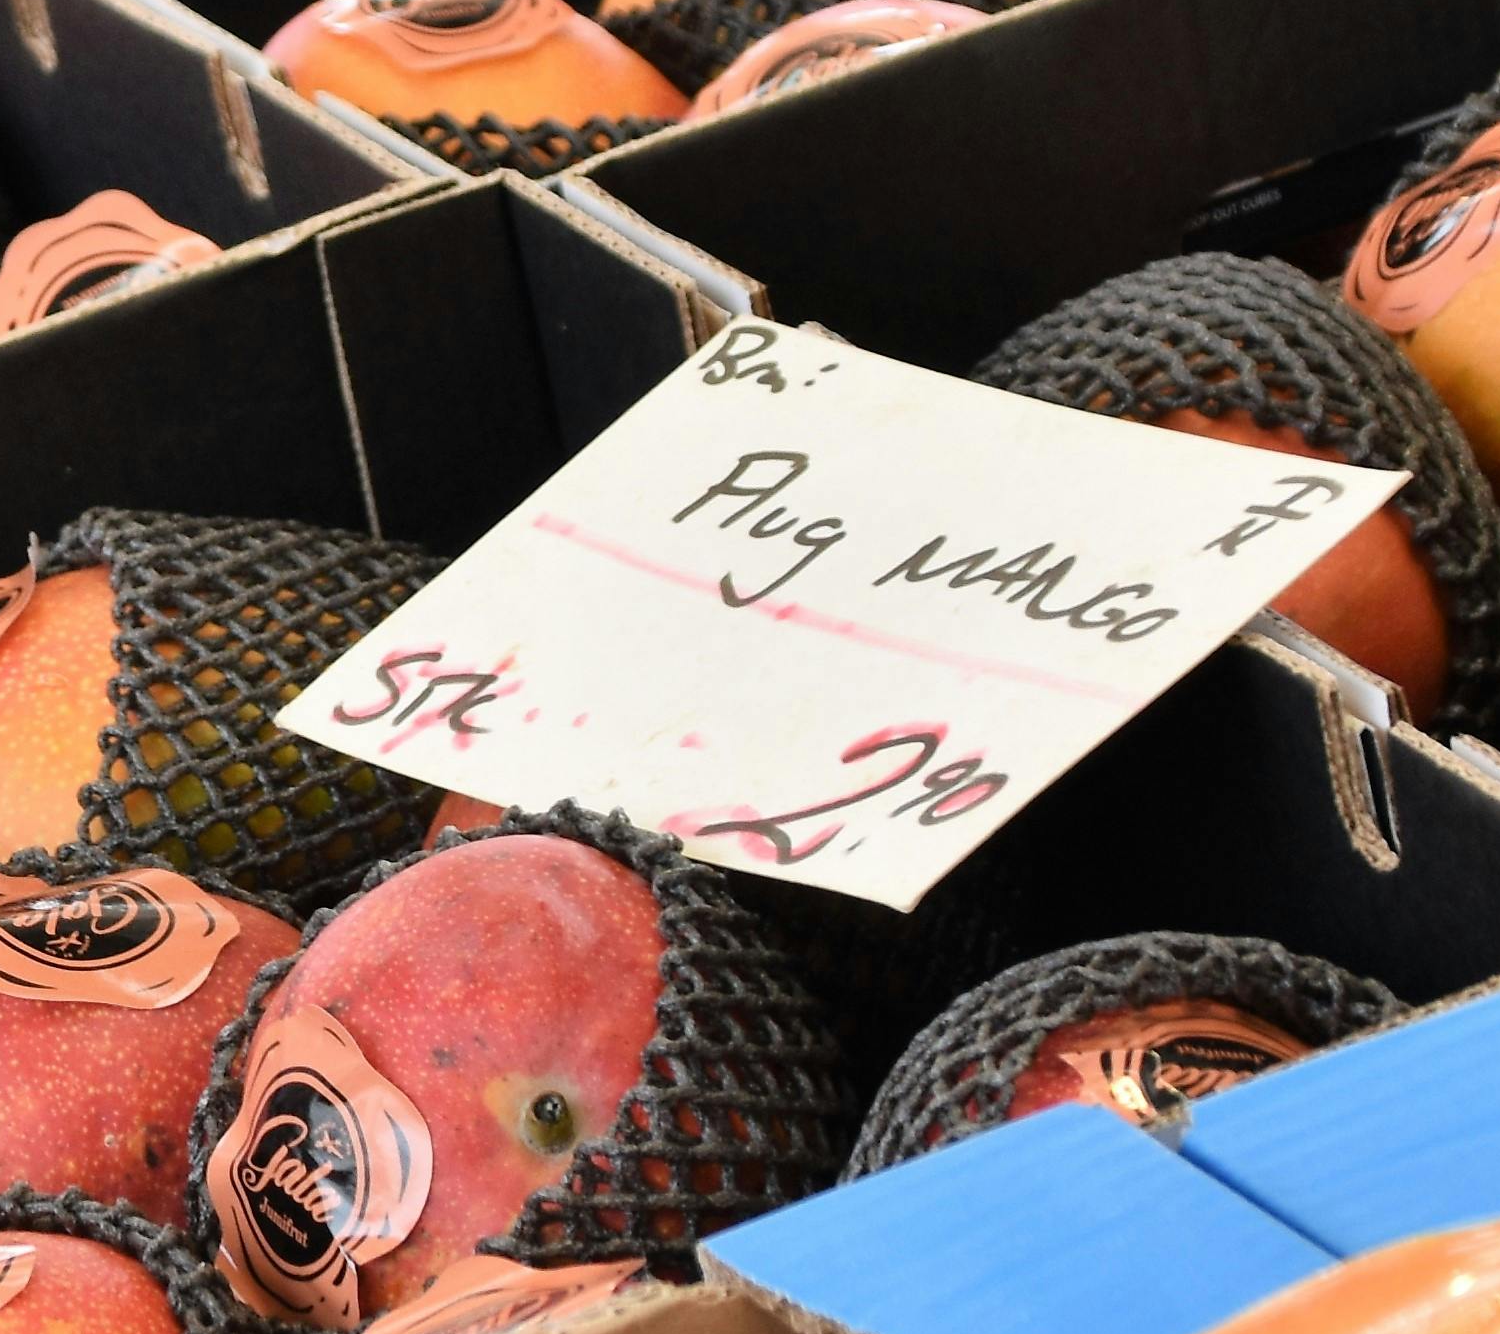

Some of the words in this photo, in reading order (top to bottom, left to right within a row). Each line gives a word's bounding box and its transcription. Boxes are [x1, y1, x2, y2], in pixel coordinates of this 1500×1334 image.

[672, 450, 847, 607] Flug
[873, 535, 1180, 643] MANGO
[11, 883, 139, 937] Gala
[241, 1113, 343, 1226] Gala
[259, 1196, 309, 1250] Jumifrut
